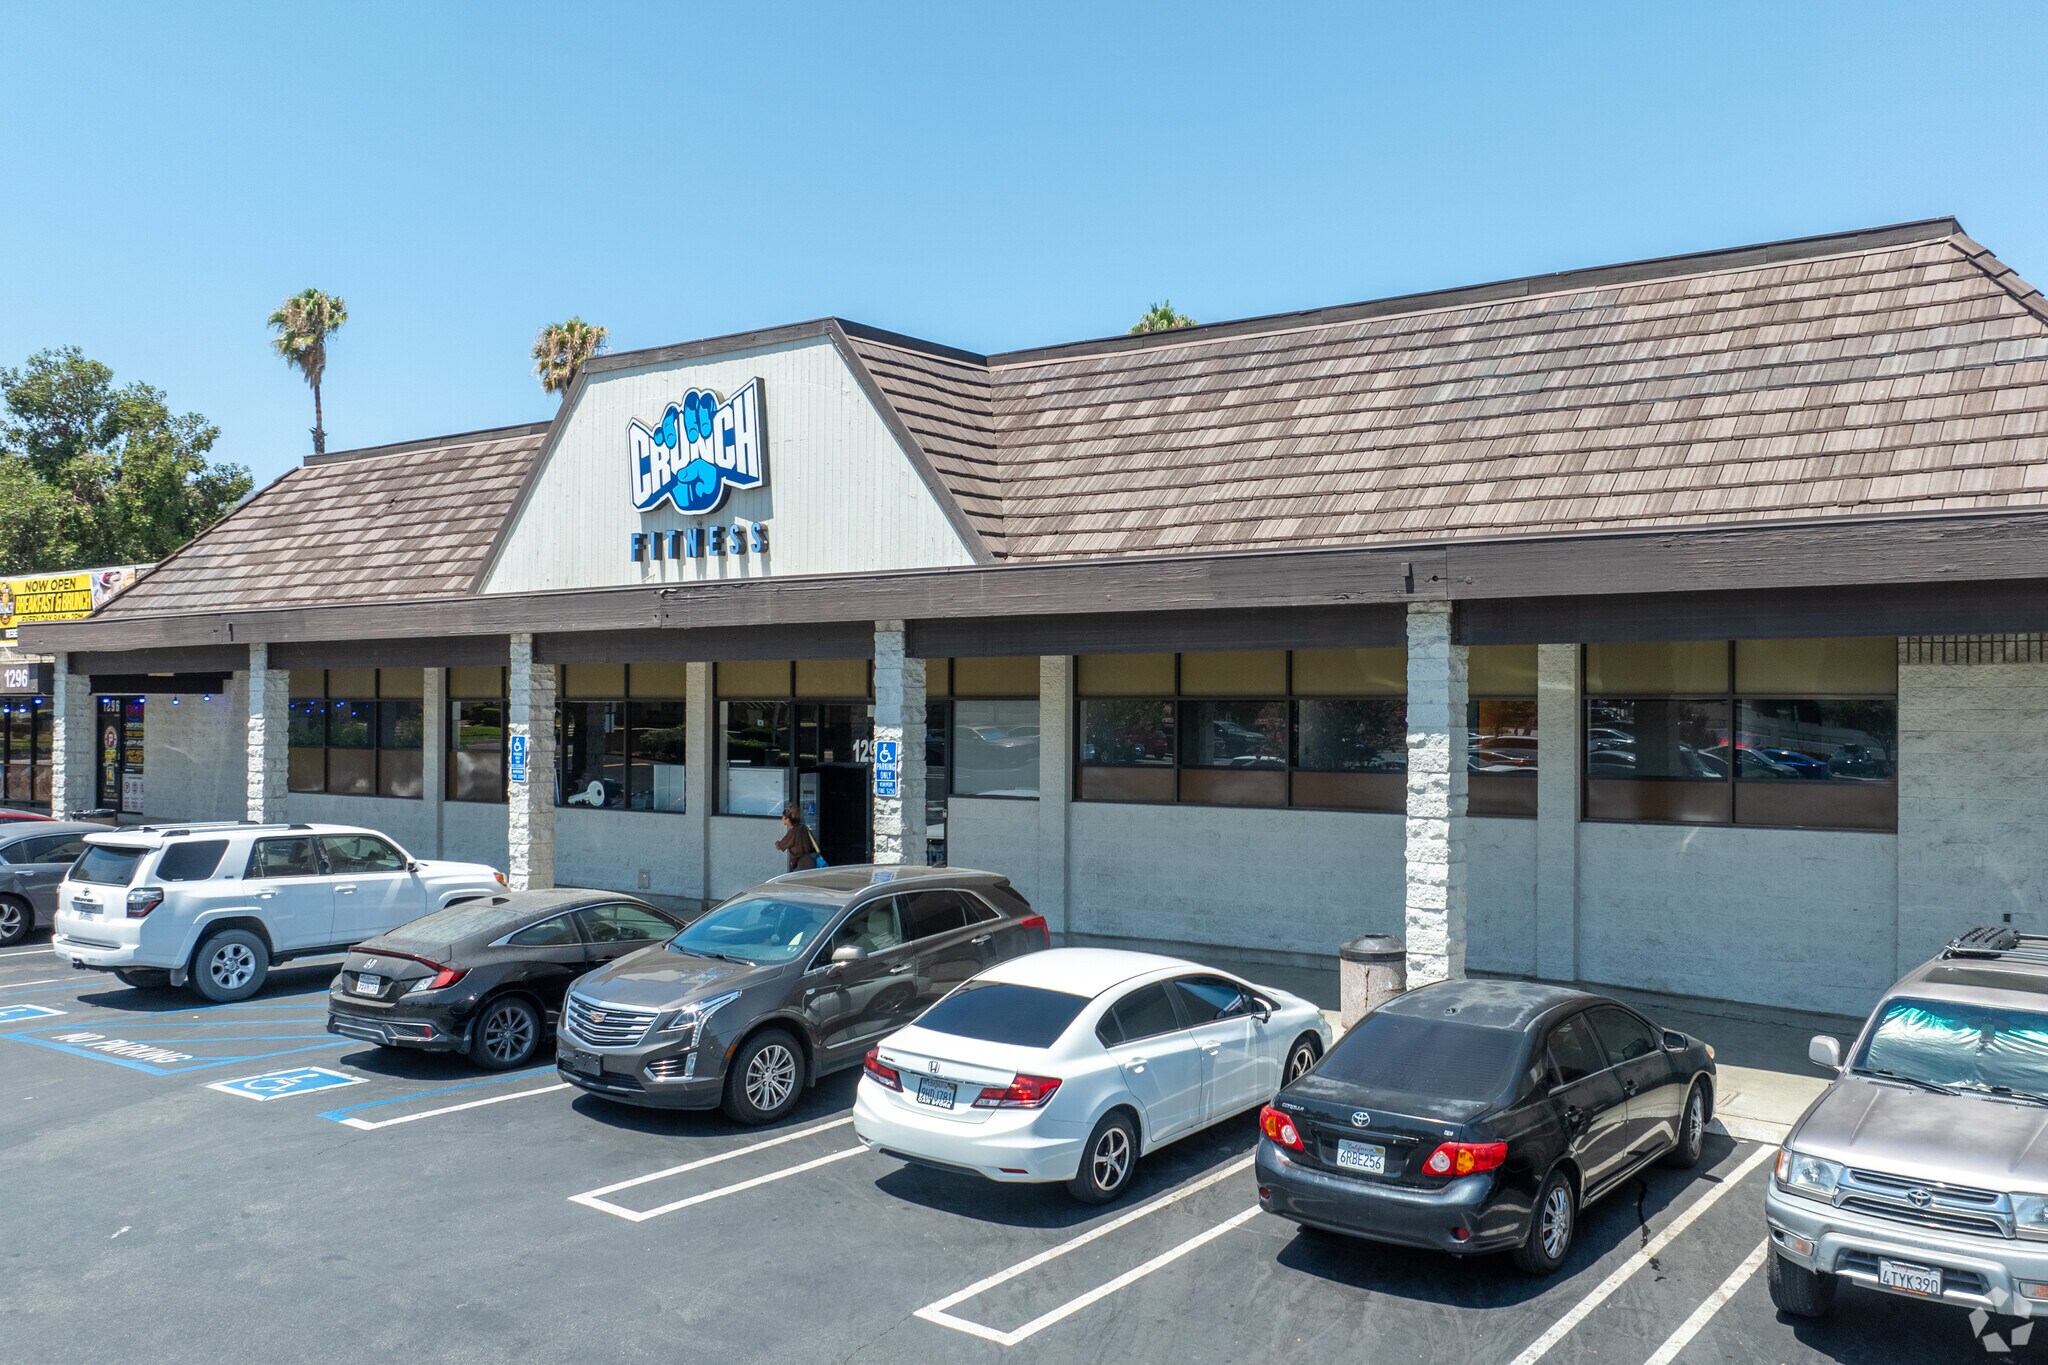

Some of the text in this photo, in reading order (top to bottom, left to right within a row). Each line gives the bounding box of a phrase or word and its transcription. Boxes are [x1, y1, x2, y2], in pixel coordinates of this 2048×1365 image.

[628, 386, 761, 509] CRUNCH
[630, 521, 768, 563] FITNESS
[25, 577, 76, 592] NOW OPEN
[15, 593, 55, 614] BREAKFAST
[55, 592, 62, 612] &
[62, 590, 90, 611] BRUNCH
[4, 669, 28, 688] 1296
[103, 699, 121, 713] 1296
[876, 763, 895, 771] PARKING
[880, 771, 892, 780] ONLY
[51, 1032, 194, 1063] NO PARKING
[1281, 1102, 1305, 1112] COROLLA
[1347, 1141, 1375, 1154] California
[1340, 1149, 1382, 1170] 6RBE256
[1882, 1270, 1939, 1294] 4TYK390
